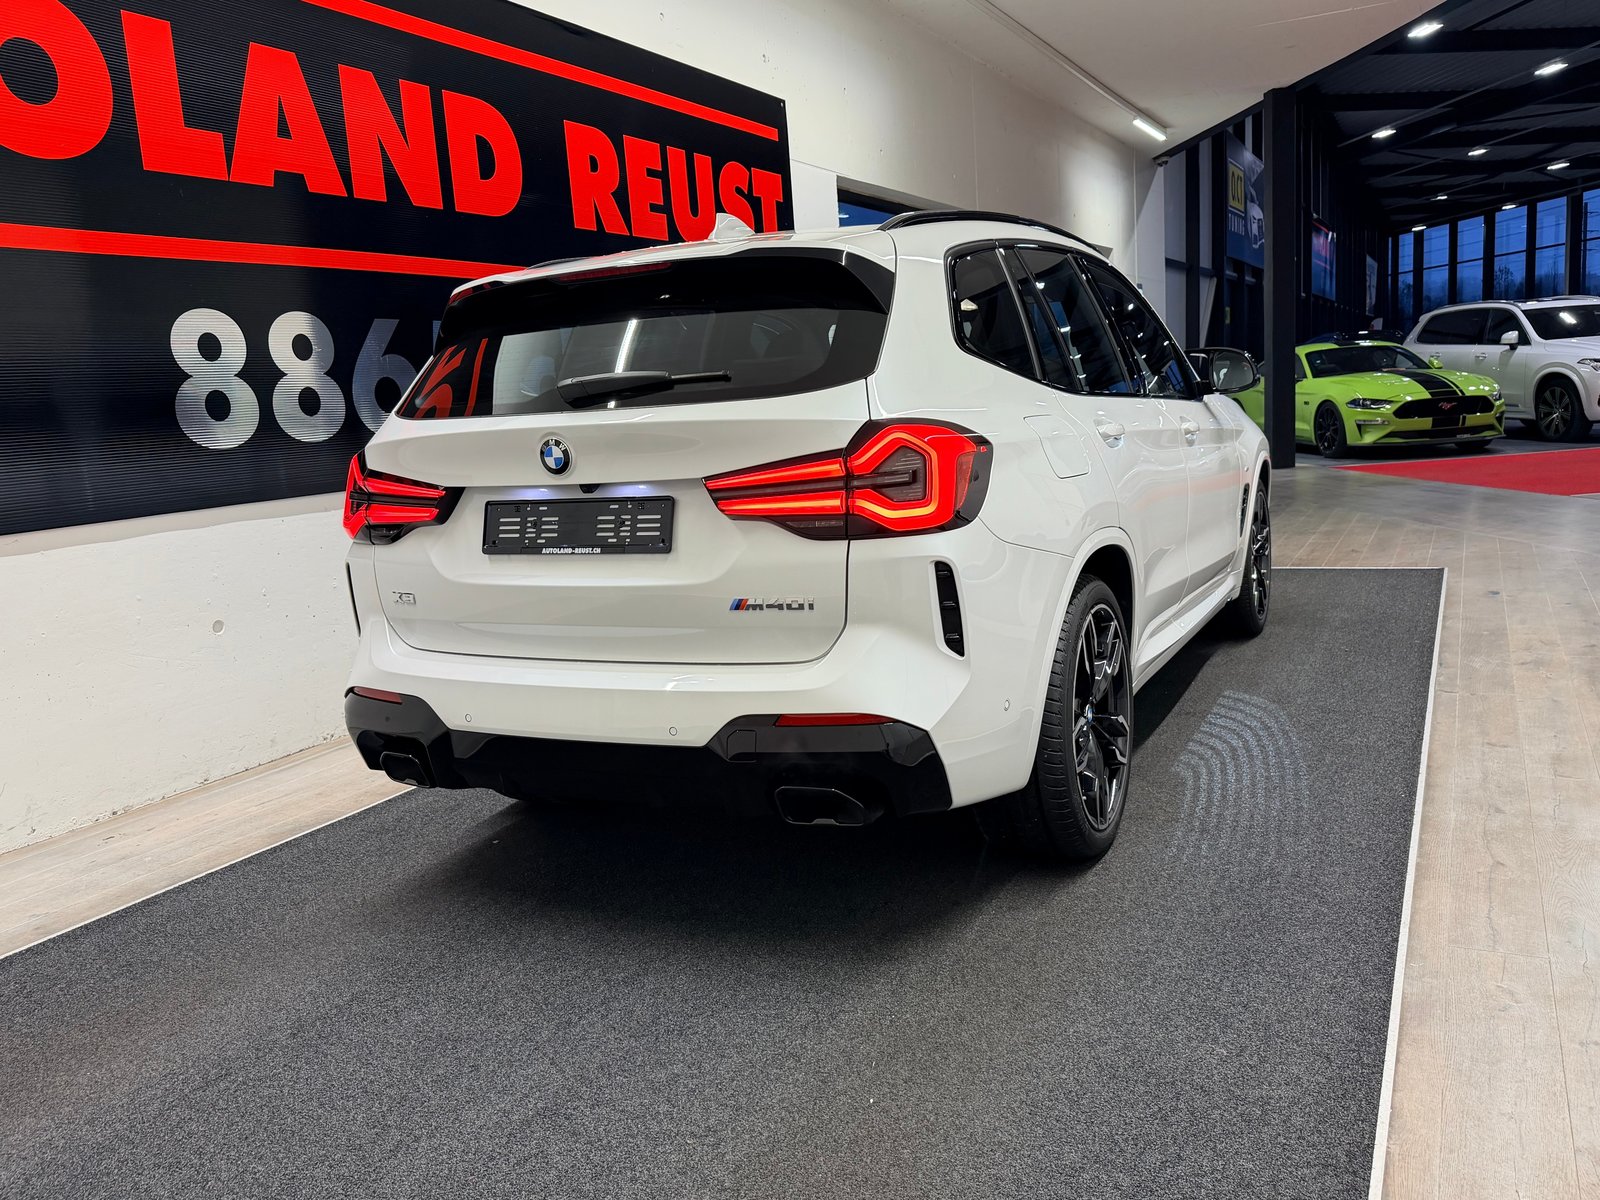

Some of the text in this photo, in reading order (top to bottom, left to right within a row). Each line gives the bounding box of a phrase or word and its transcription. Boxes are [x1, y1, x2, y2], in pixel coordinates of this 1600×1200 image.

[0, 0, 784, 243] OLAND REUST
[170, 307, 442, 449] 886
[392, 591, 417, 606] X3
